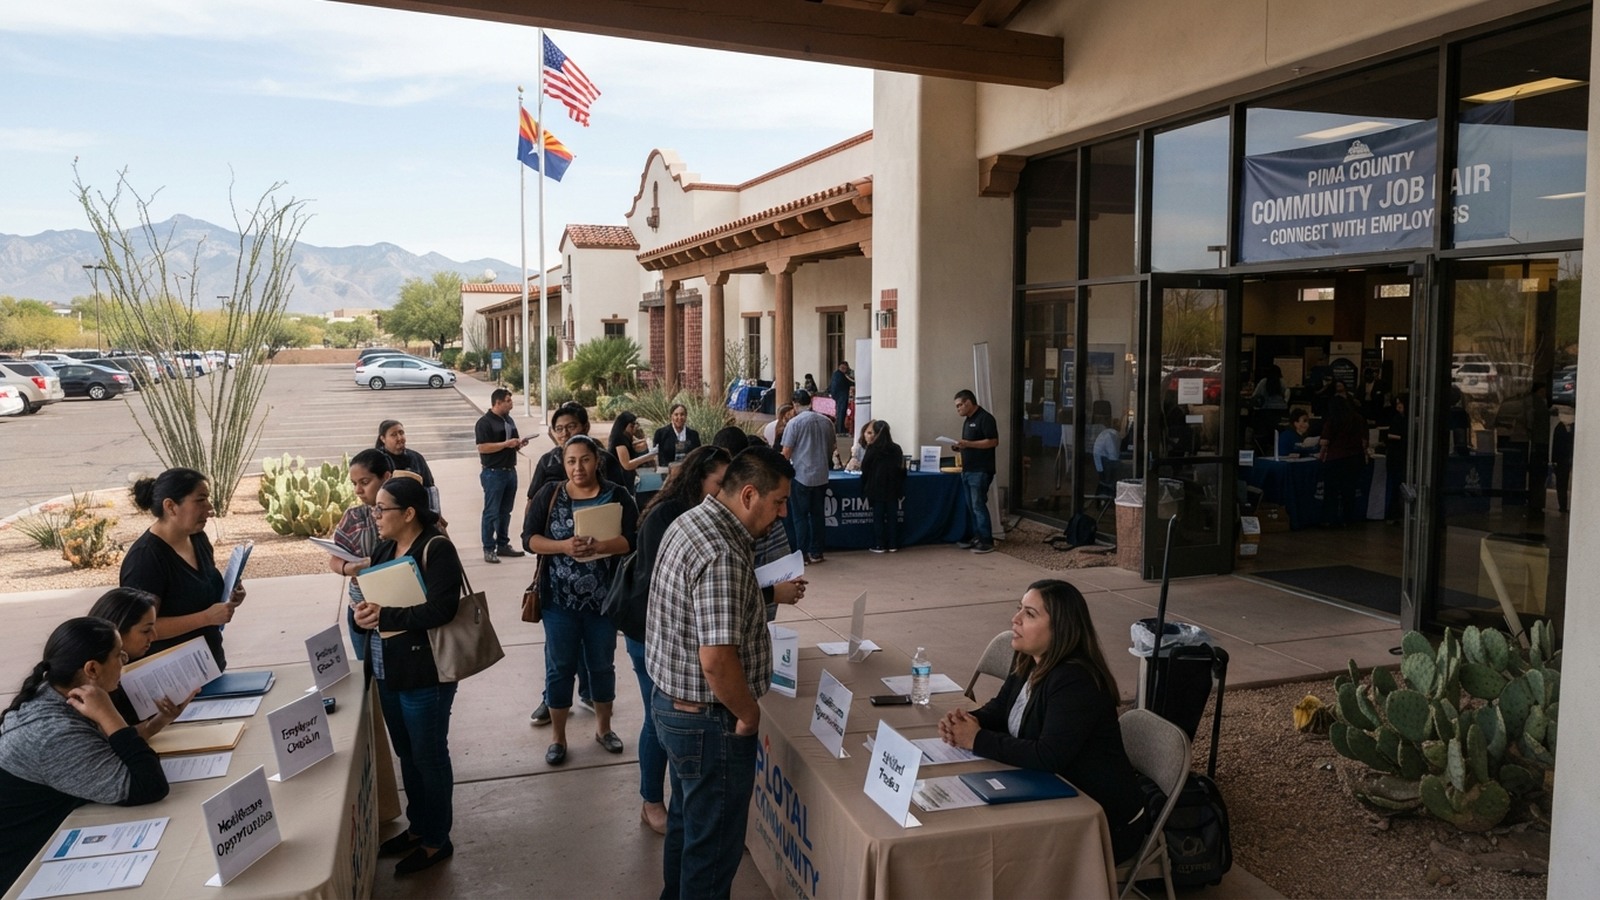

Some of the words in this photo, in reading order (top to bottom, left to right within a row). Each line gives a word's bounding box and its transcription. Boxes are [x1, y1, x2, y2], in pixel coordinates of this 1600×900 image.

[1308, 164, 1345, 188] PIMA
[1349, 150, 1415, 181] COUNTY
[1251, 183, 1373, 225] COMMUNITY
[1379, 175, 1425, 209] JOB
[1432, 164, 1491, 200] AIR
[1331, 218, 1367, 239] WITH
[1370, 204, 1470, 235] EMPLOYS
[841, 497, 874, 511] PIM
